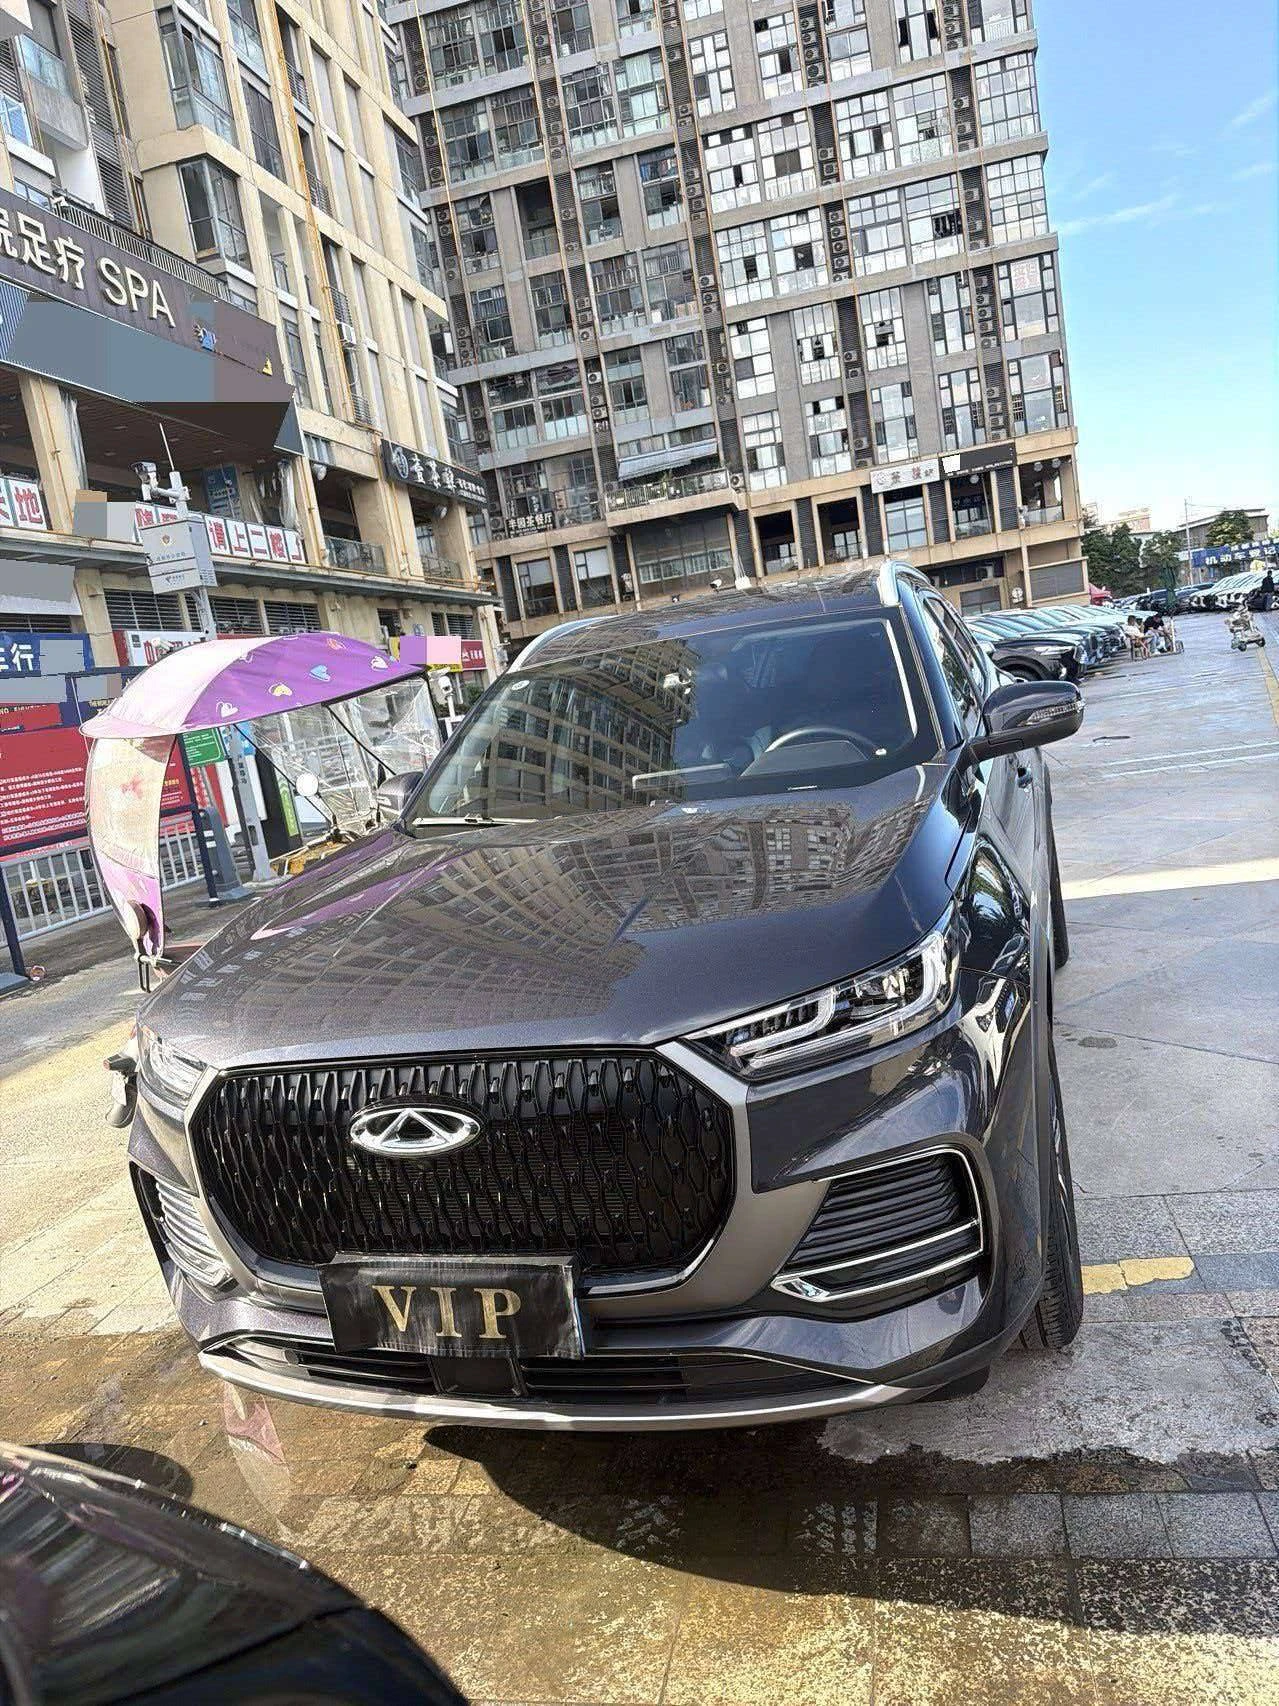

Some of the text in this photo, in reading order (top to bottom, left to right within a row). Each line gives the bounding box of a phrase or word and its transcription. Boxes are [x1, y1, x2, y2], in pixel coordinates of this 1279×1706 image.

[99, 257, 176, 328] SPA
[0, 643, 34, 672] 行
[372, 1285, 522, 1339] VIP
